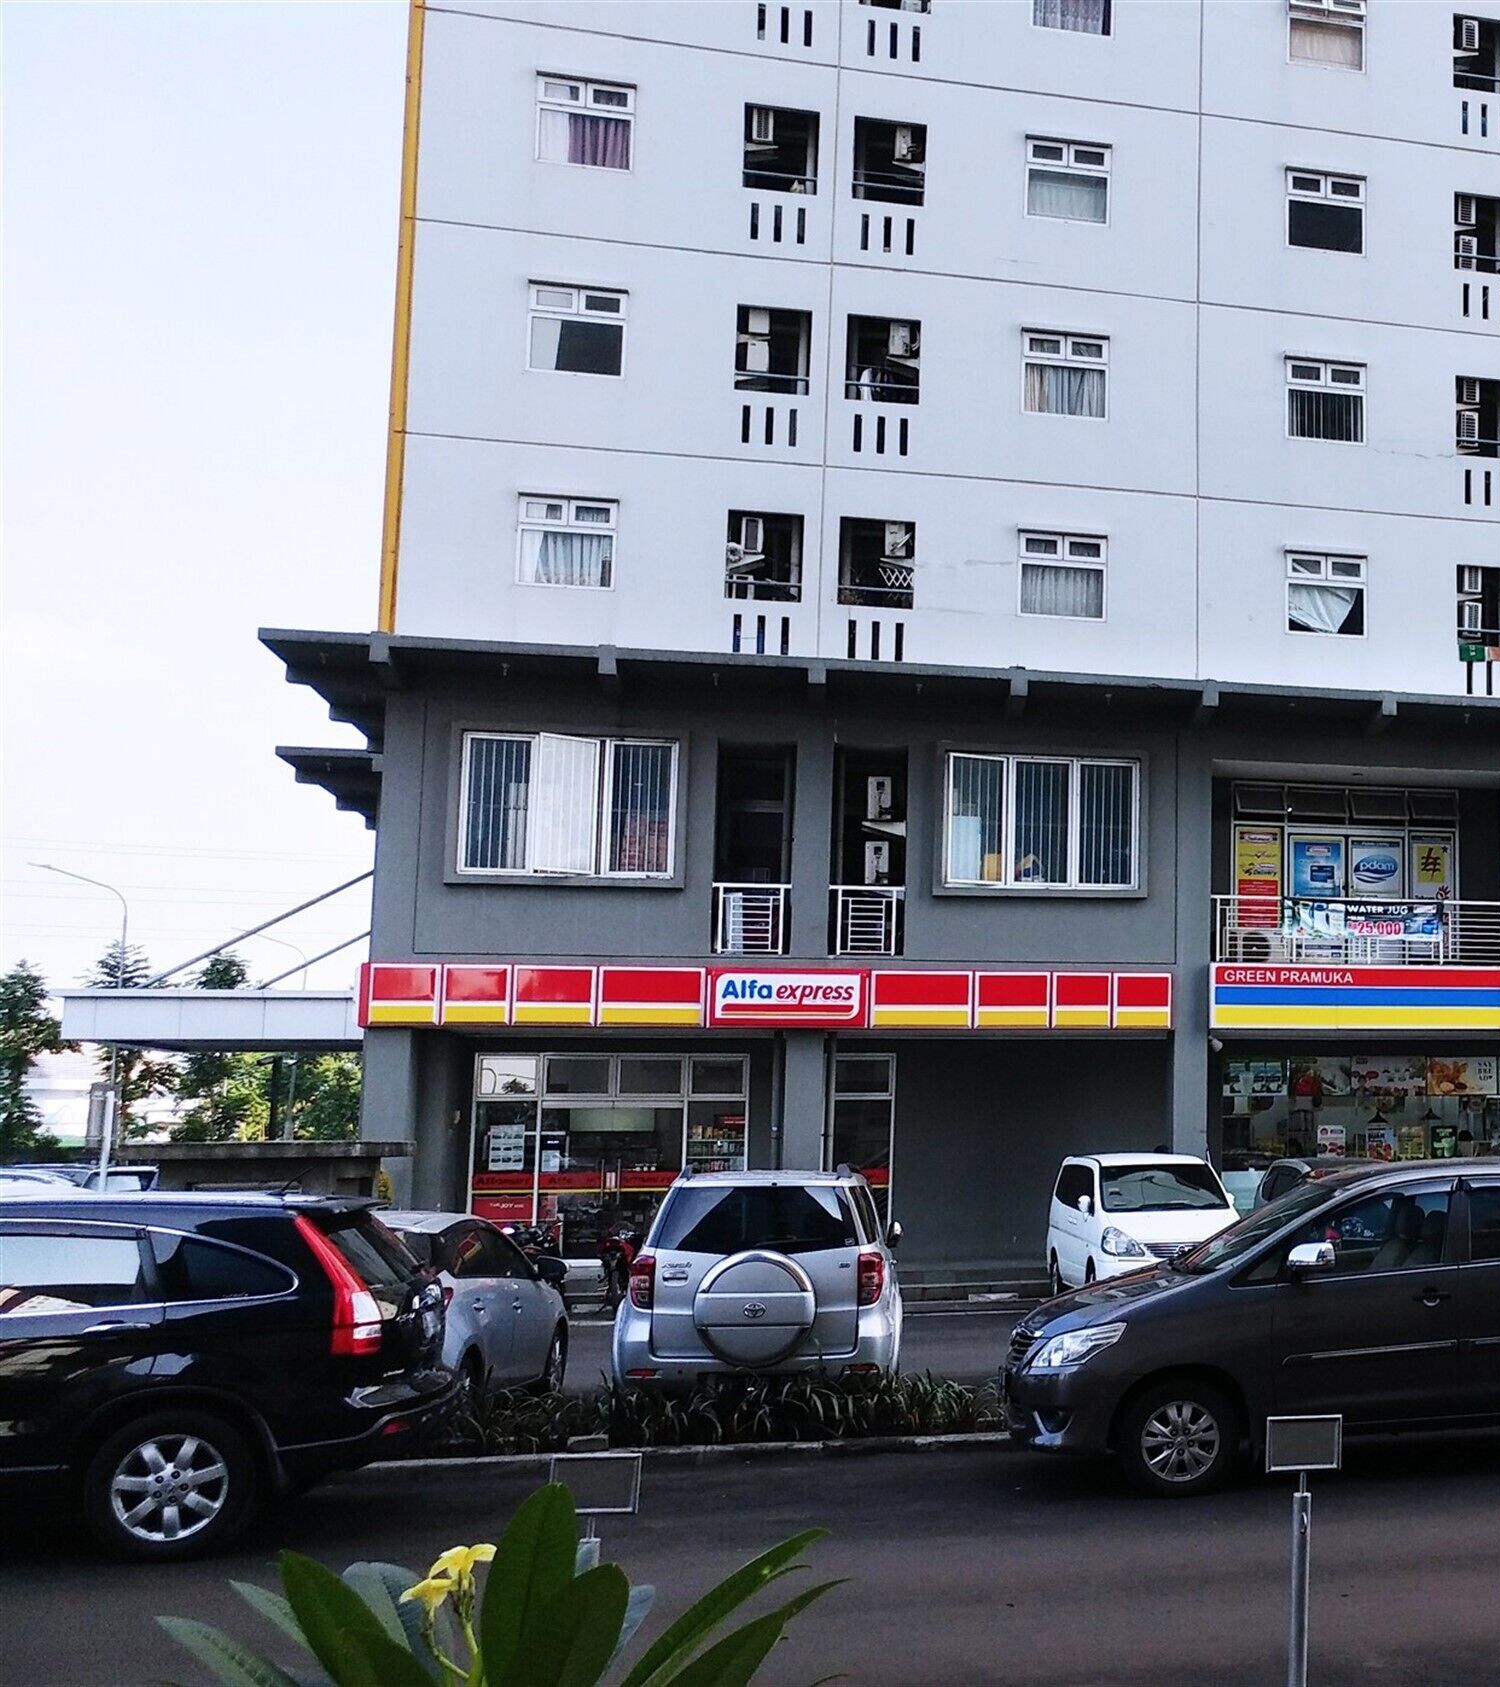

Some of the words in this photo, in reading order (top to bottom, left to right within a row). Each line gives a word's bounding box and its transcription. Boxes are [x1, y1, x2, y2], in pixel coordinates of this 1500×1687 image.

[1360, 859, 1395, 872] pdam
[1347, 904, 1384, 914] WATER
[1387, 905, 1408, 915] JUG
[1224, 969, 1276, 983] GREEN
[1280, 970, 1354, 984] PRAMUKA
[721, 979, 773, 999] Alfa
[776, 984, 855, 1004] express
